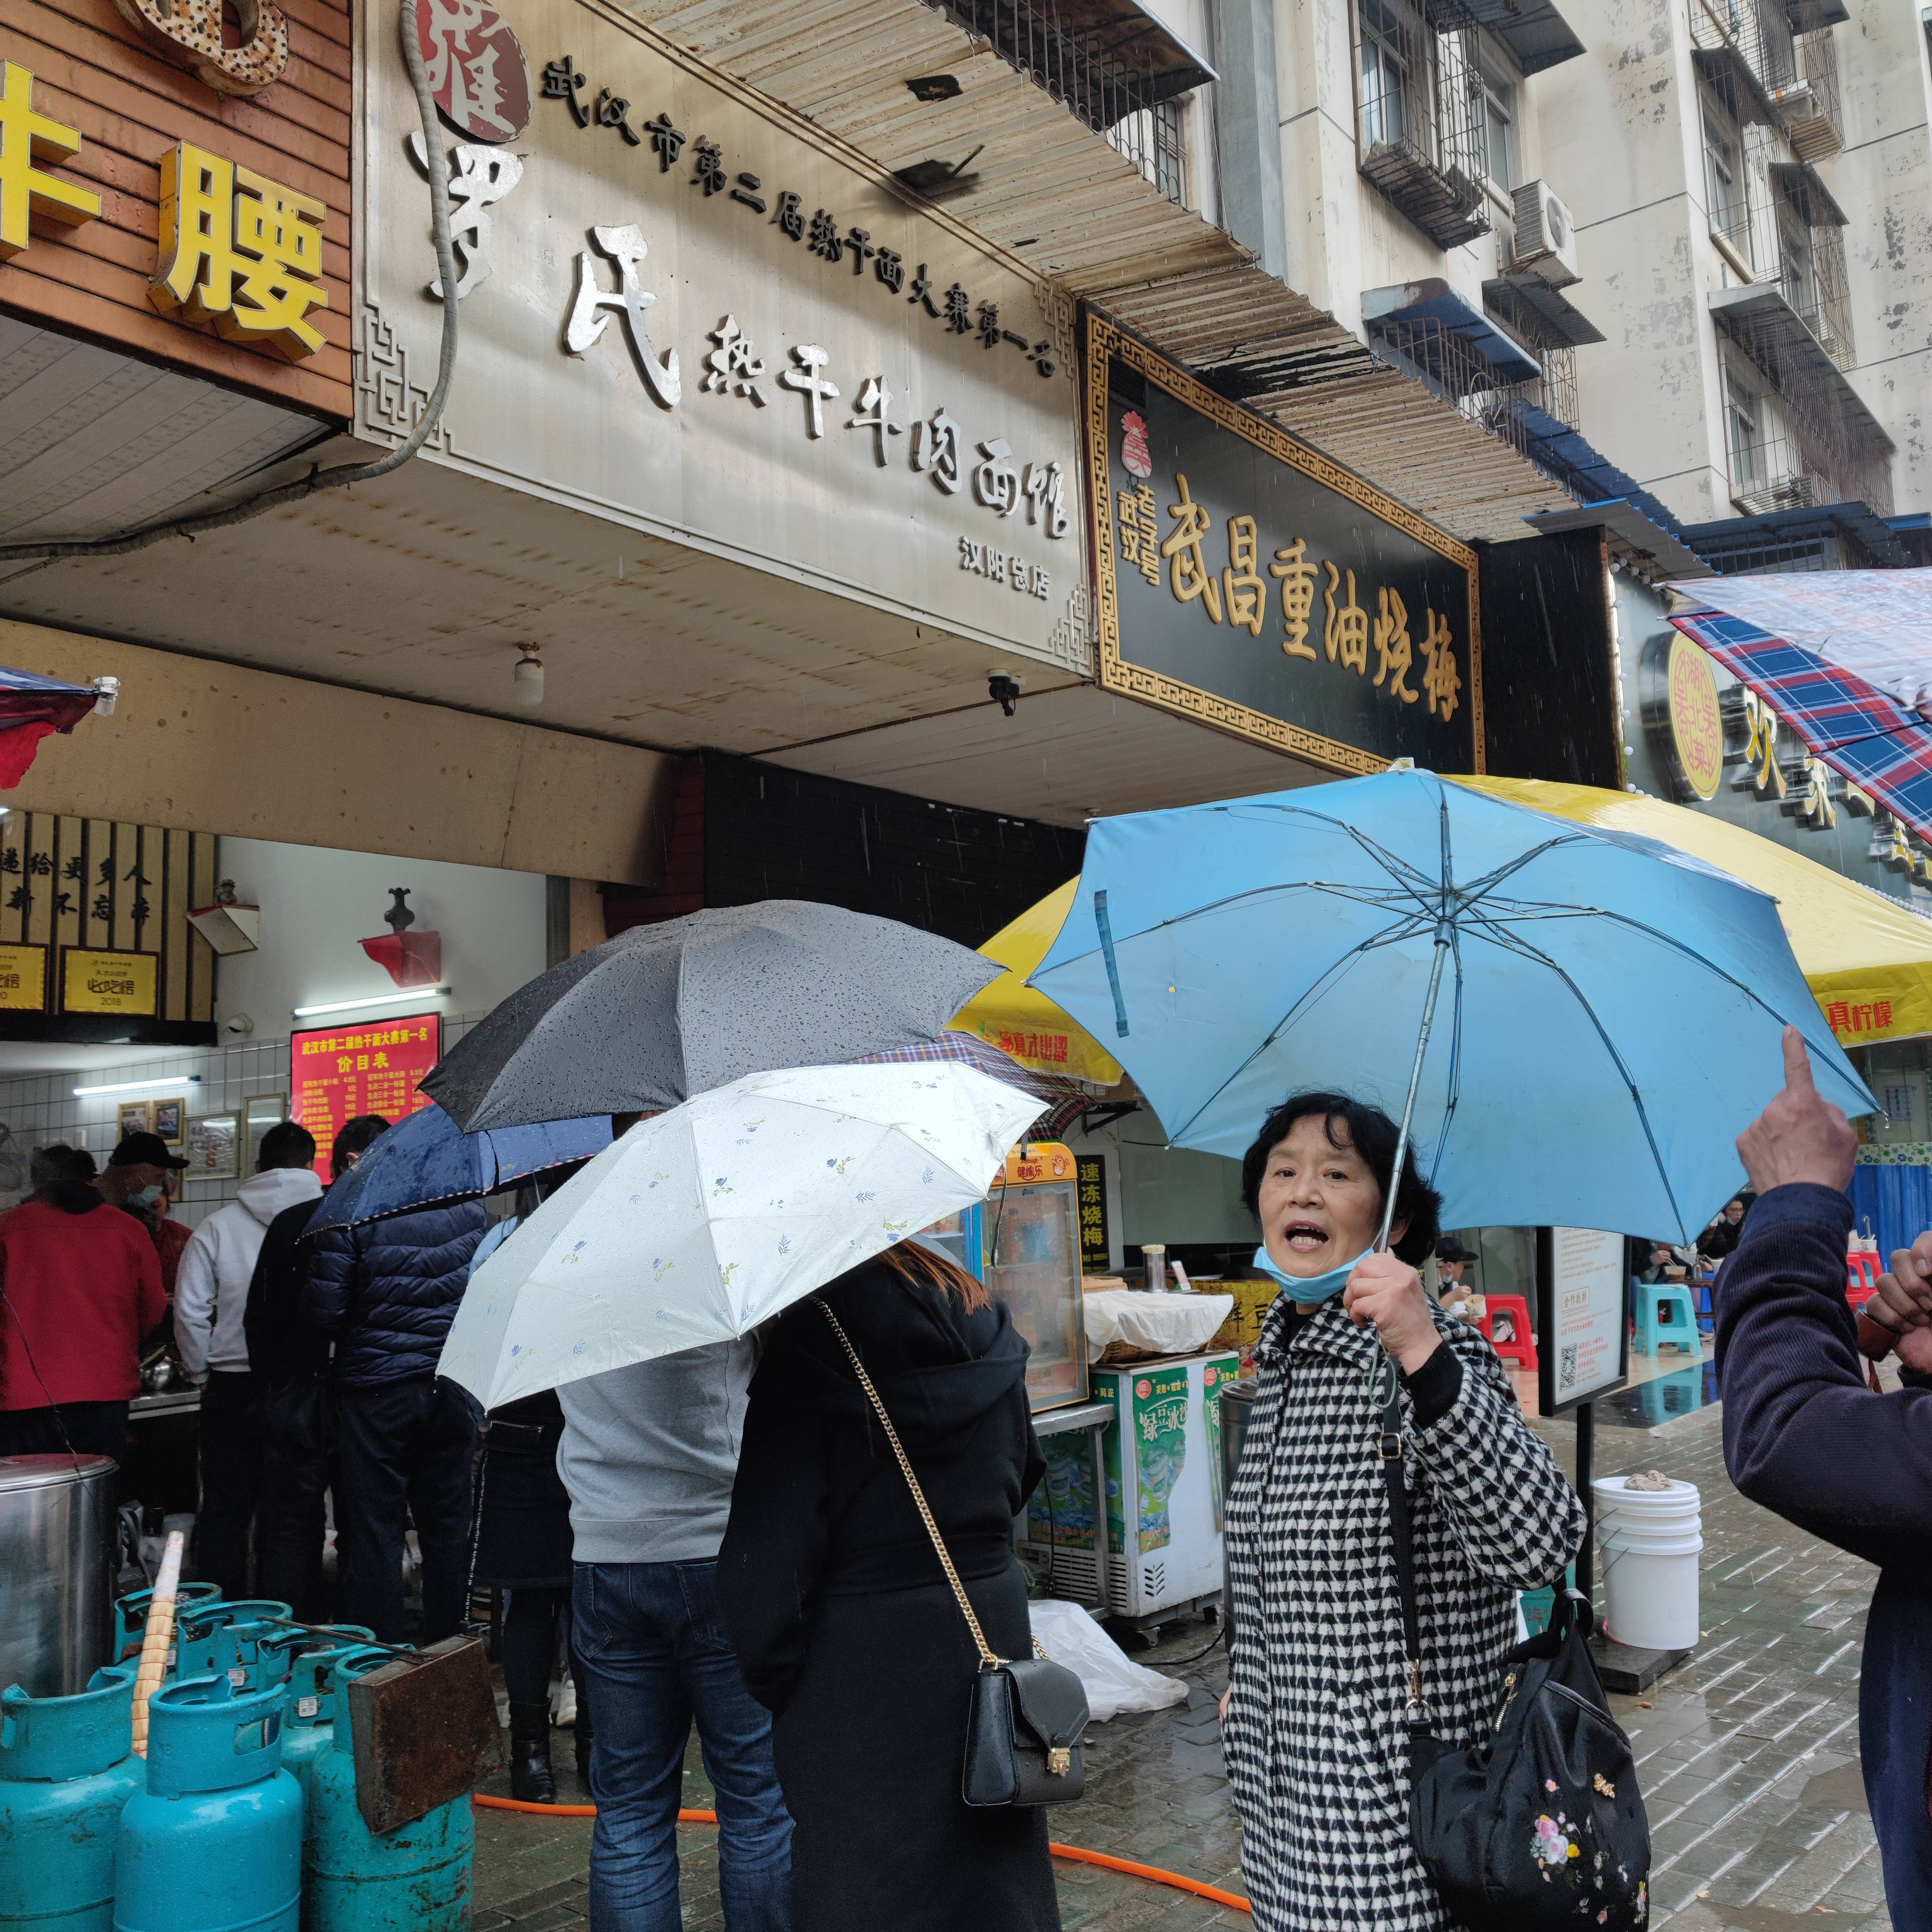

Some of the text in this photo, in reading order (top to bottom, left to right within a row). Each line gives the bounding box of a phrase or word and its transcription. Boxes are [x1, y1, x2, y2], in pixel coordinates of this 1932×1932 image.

[541, 55, 1055, 378] 武汉市第二届热干面大赛第一名
[1117, 489, 1141, 565] 武汉
[1137, 483, 1160, 587] 老字号
[959, 535, 1050, 600] 汉阳总店
[1161, 472, 1461, 722] 武昌重油烧梅
[1685, 650, 1708, 775] 湖北菜
[301, 1027, 428, 1055] 武汉市第二届热干面大赛第一名
[1826, 1000, 1893, 1035] 真柠檬
[337, 1051, 390, 1074] 价目表
[1080, 1163, 1103, 1247] 速冻烧梅
